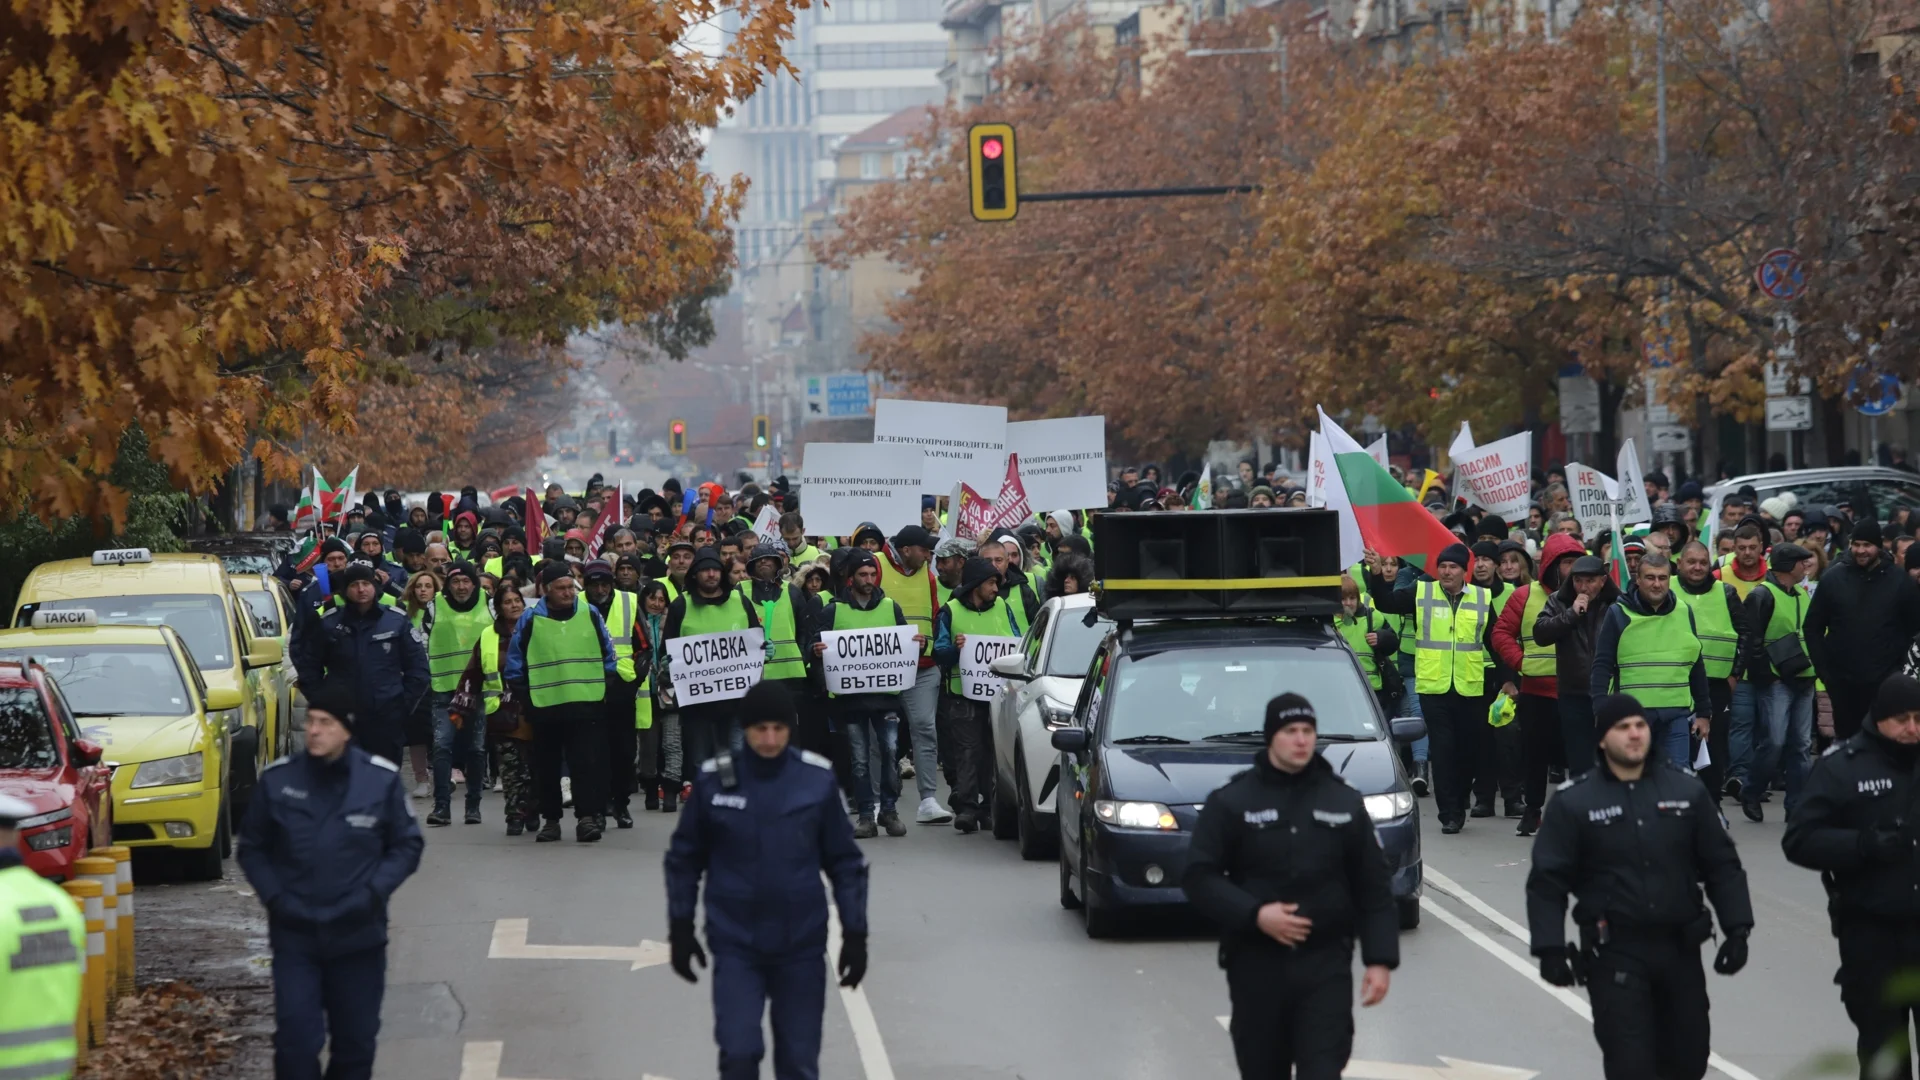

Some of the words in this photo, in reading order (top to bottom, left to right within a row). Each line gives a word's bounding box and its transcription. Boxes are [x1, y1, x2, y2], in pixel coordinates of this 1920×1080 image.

[876, 434, 1003, 450] ЗЕЛЕНЧУКОПРОИЗВОДИТЕЛИ
[924, 449, 973, 460] ХАРМАНЛИ
[1027, 465, 1083, 476] МОМЧИЛГРАД
[1457, 452, 1502, 477] ПАСИМ
[802, 477, 921, 486] ЗЕЛЕНЧУКОПРОИЗВОДИТЕЛИ
[1468, 467, 1515, 492] СТВОТО
[1577, 471, 1596, 486] НЕ
[847, 489, 892, 498] ЛЮБИМЕЦ
[101, 551, 142, 561] ТАКСИ
[44, 611, 86, 623] ТАКСИ
[682, 636, 748, 666] ОСТАВКА
[837, 632, 902, 659] ОСТАВКА
[674, 673, 687, 681] ЗА
[690, 660, 763, 679] ГРОБОКОПАЧА
[826, 665, 839, 673] ЗА
[842, 659, 916, 672] ГРОБОКОПАЧА
[961, 668, 974, 677] ЗА
[689, 675, 752, 697] ВЪТЕВ!
[841, 673, 903, 690] ВЪТЕВ!
